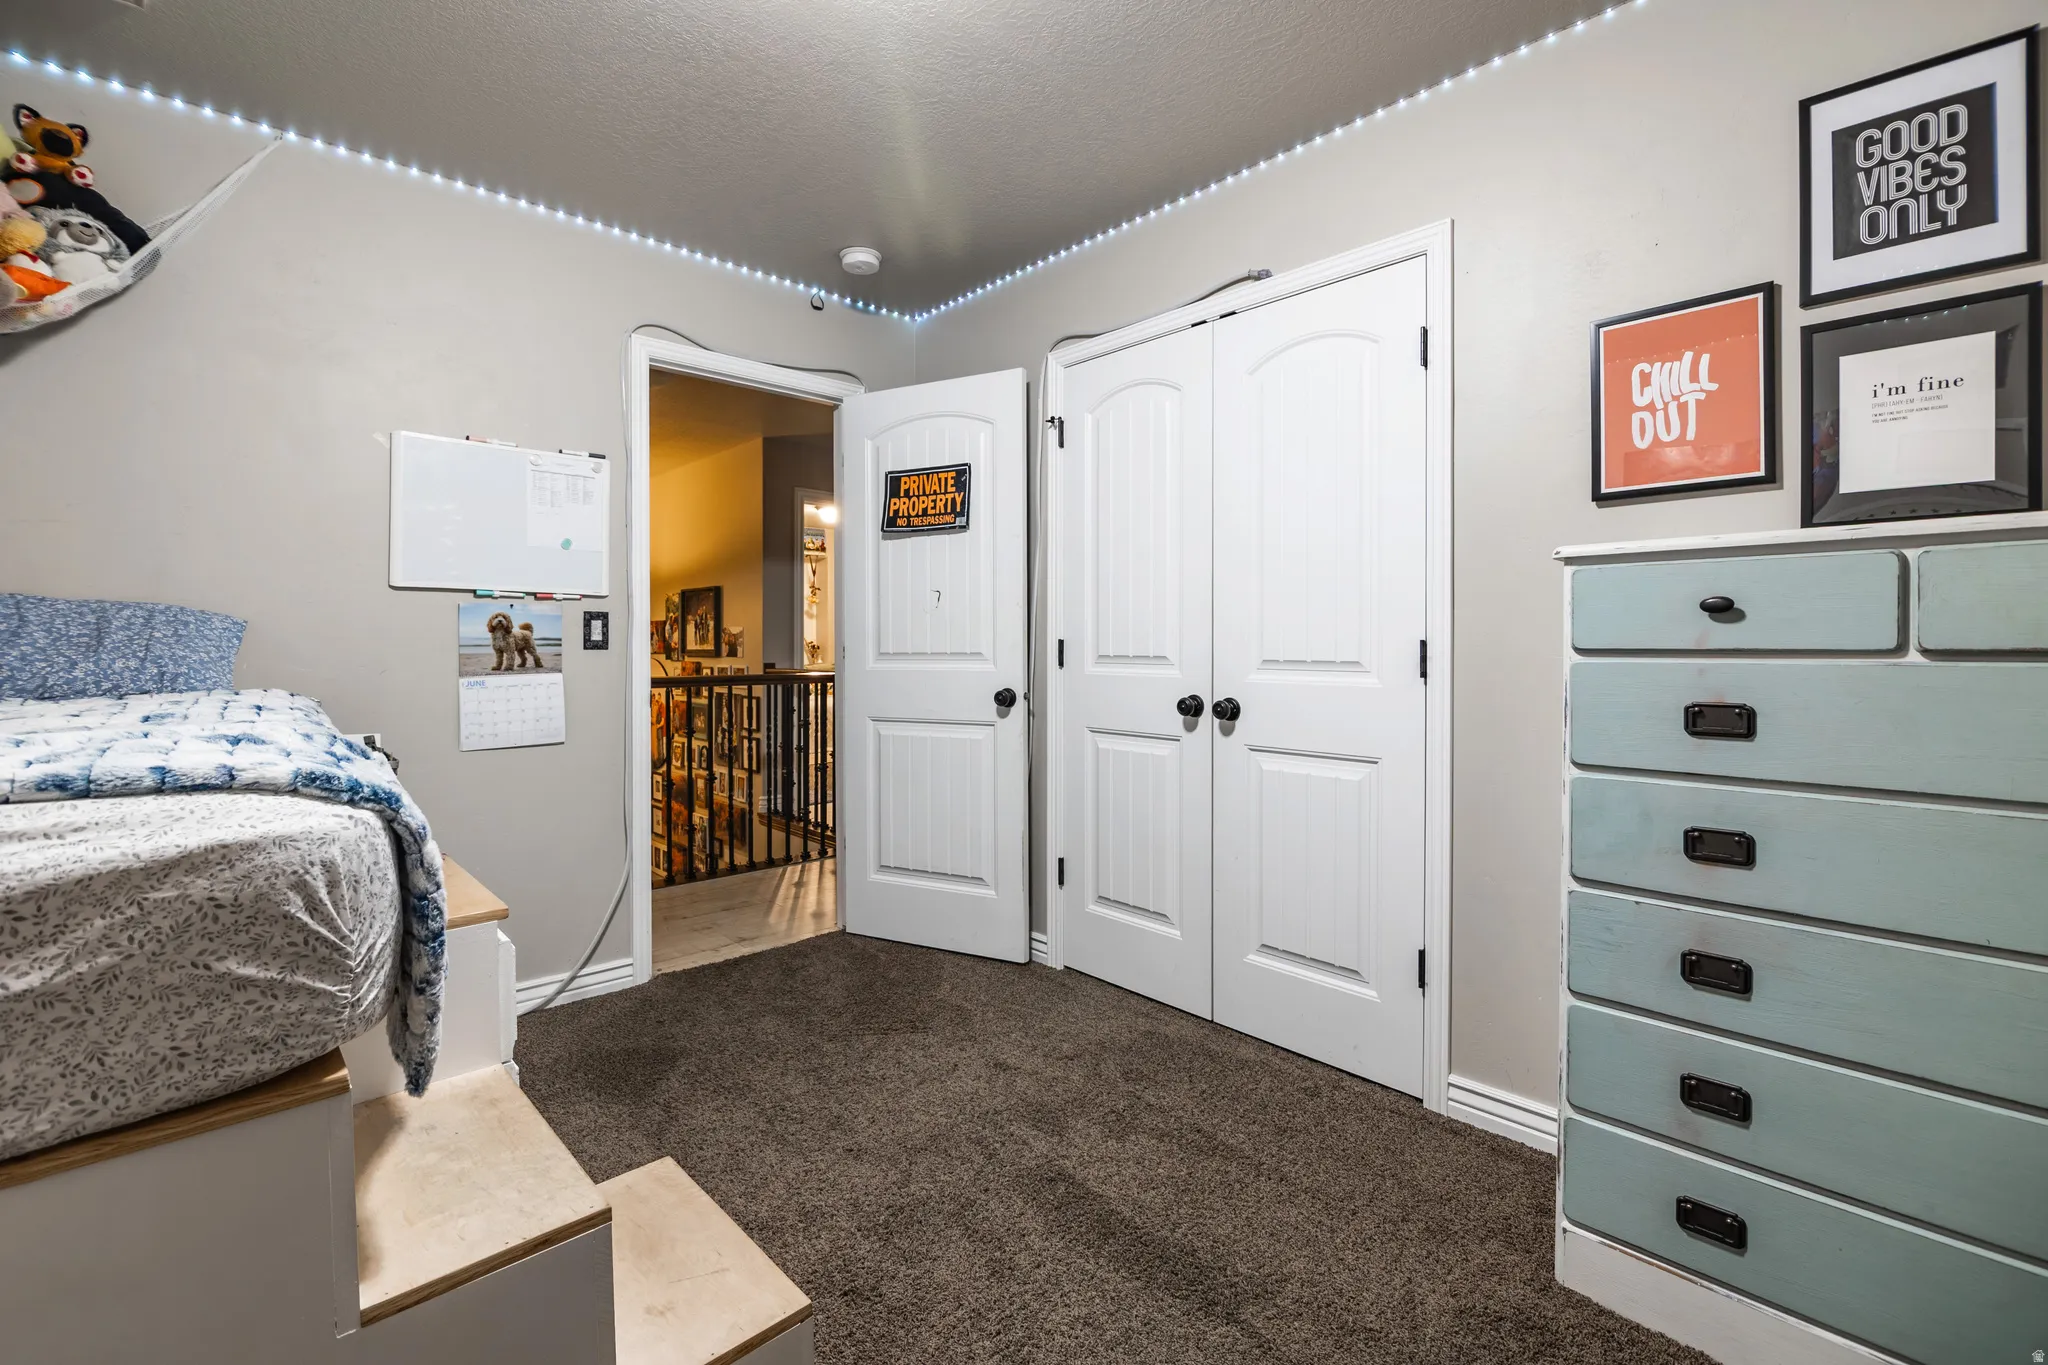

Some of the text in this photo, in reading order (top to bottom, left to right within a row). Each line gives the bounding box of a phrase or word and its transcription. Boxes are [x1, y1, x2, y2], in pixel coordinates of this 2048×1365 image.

[1855, 104, 1968, 168] GOOD
[1857, 145, 1967, 206] VIBES
[1859, 183, 1968, 245] ONLY
[1631, 351, 1719, 410] CHILL
[1872, 376, 1964, 398] i'm fine
[1631, 391, 1706, 449] OUT
[889, 492, 964, 517] PROPERTY
[900, 471, 956, 497] PRIVATE
[896, 514, 955, 526] NO TRESPASSING
